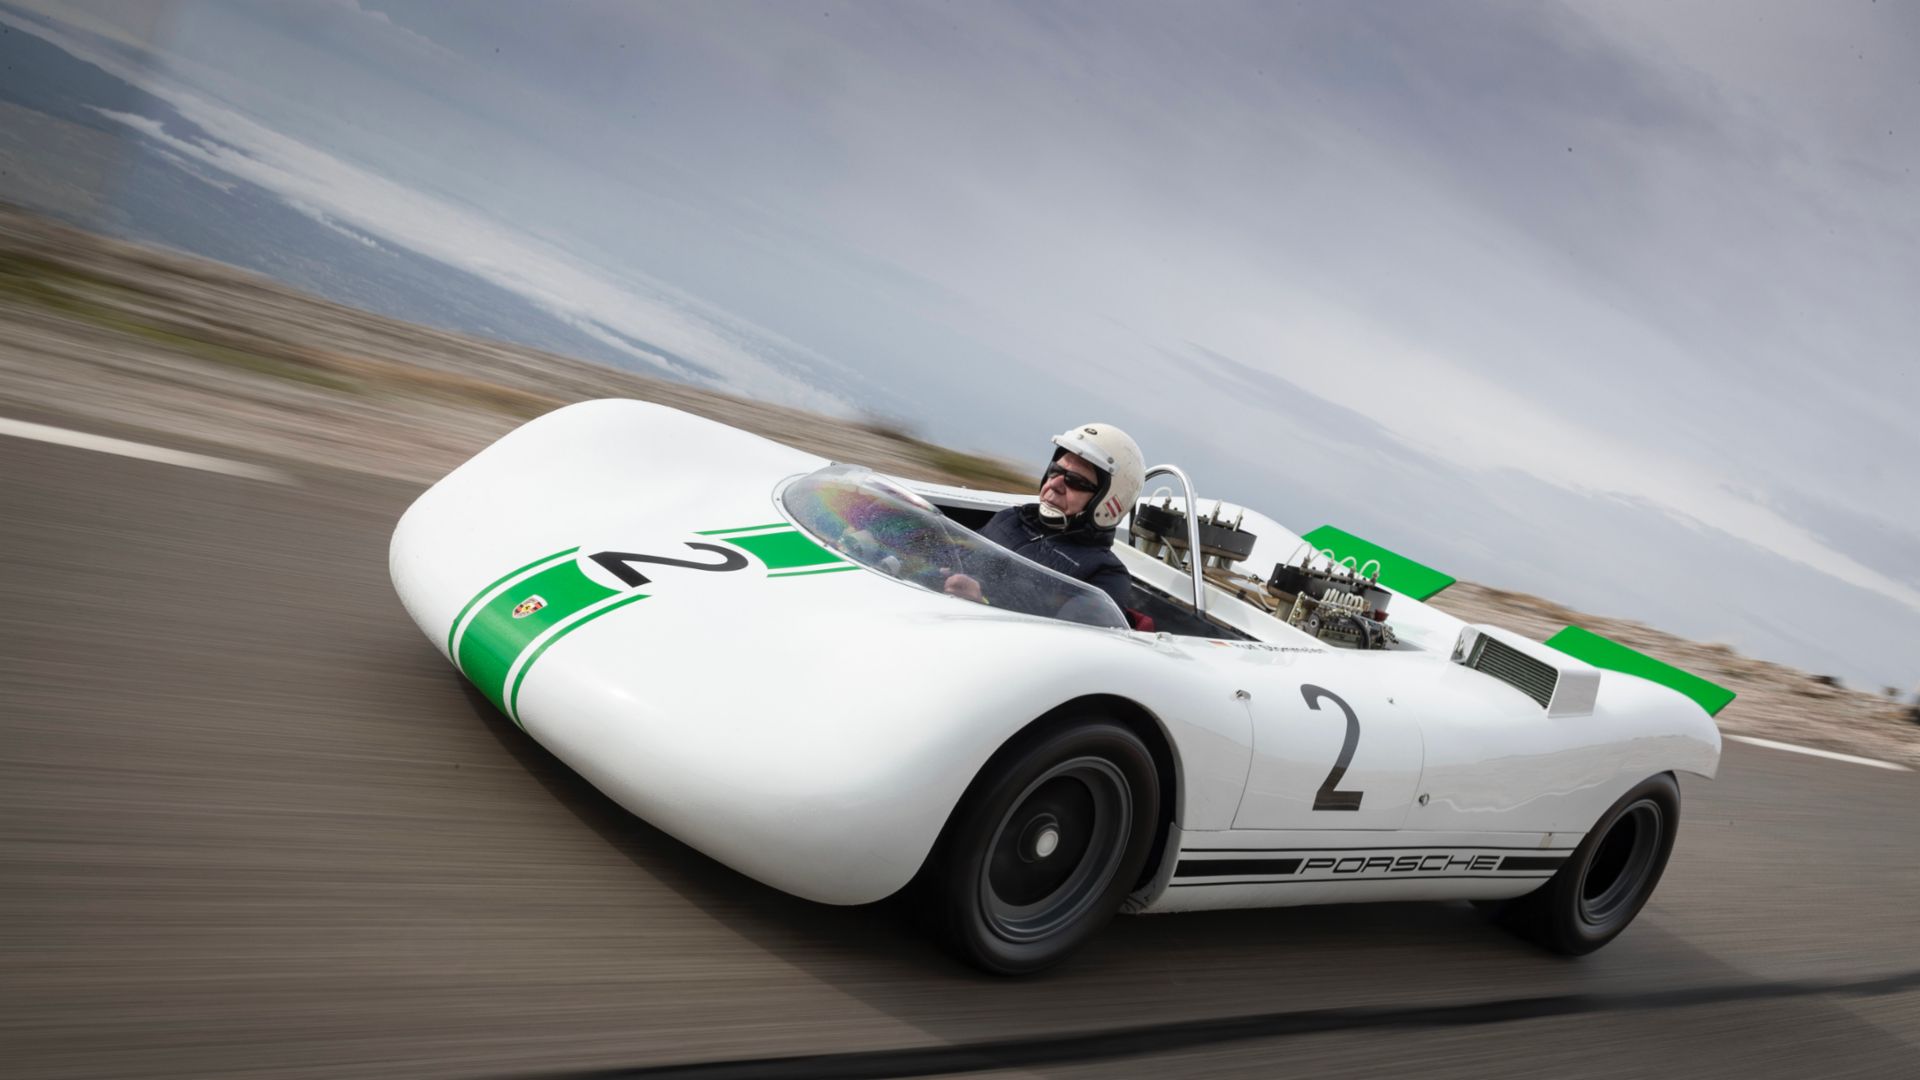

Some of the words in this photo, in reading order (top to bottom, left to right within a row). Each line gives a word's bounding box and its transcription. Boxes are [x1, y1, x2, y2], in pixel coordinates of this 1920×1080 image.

[587, 542, 749, 588] 2
[1300, 684, 1364, 811] 2
[1300, 855, 1500, 874] PORSCHE
